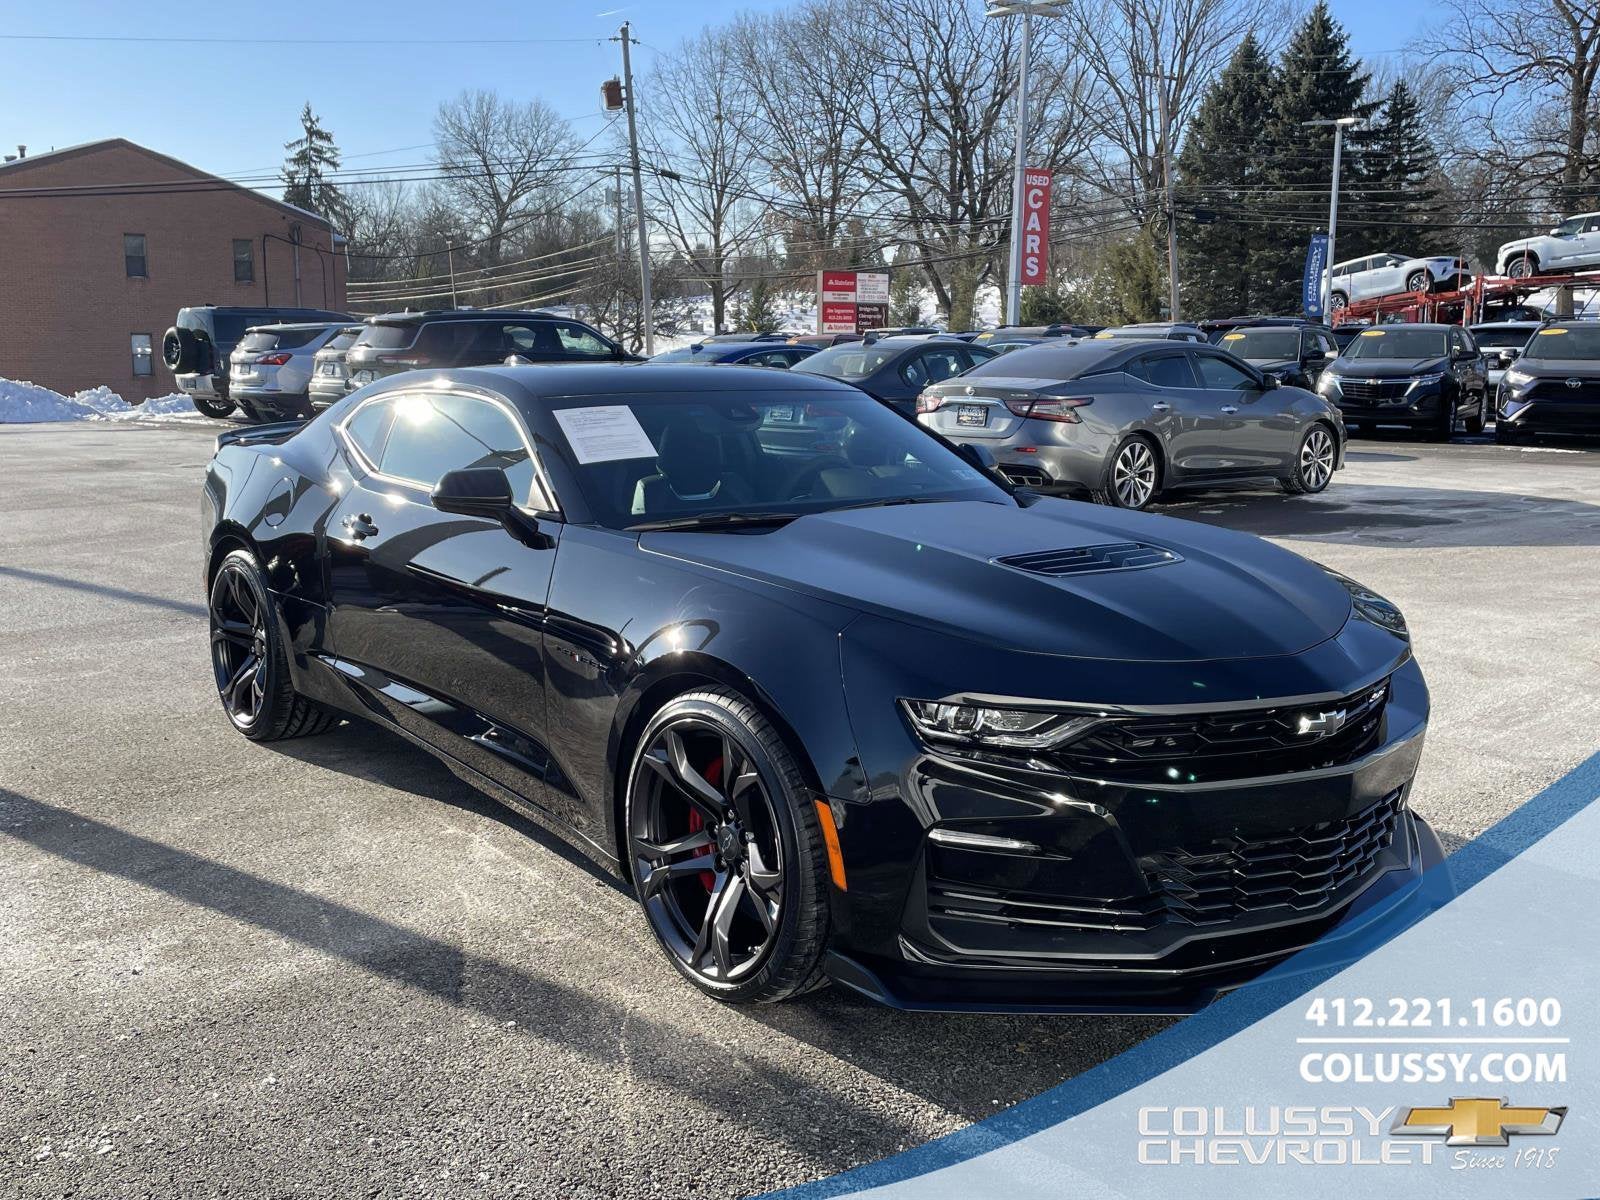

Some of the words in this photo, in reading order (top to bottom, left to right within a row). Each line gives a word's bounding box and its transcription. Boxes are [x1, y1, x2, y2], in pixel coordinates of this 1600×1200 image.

[1026, 174, 1049, 186] USED
[1026, 188, 1044, 277] CARS
[1308, 246, 1318, 302] COLUSSY
[1312, 246, 1322, 302] CHEVROLET
